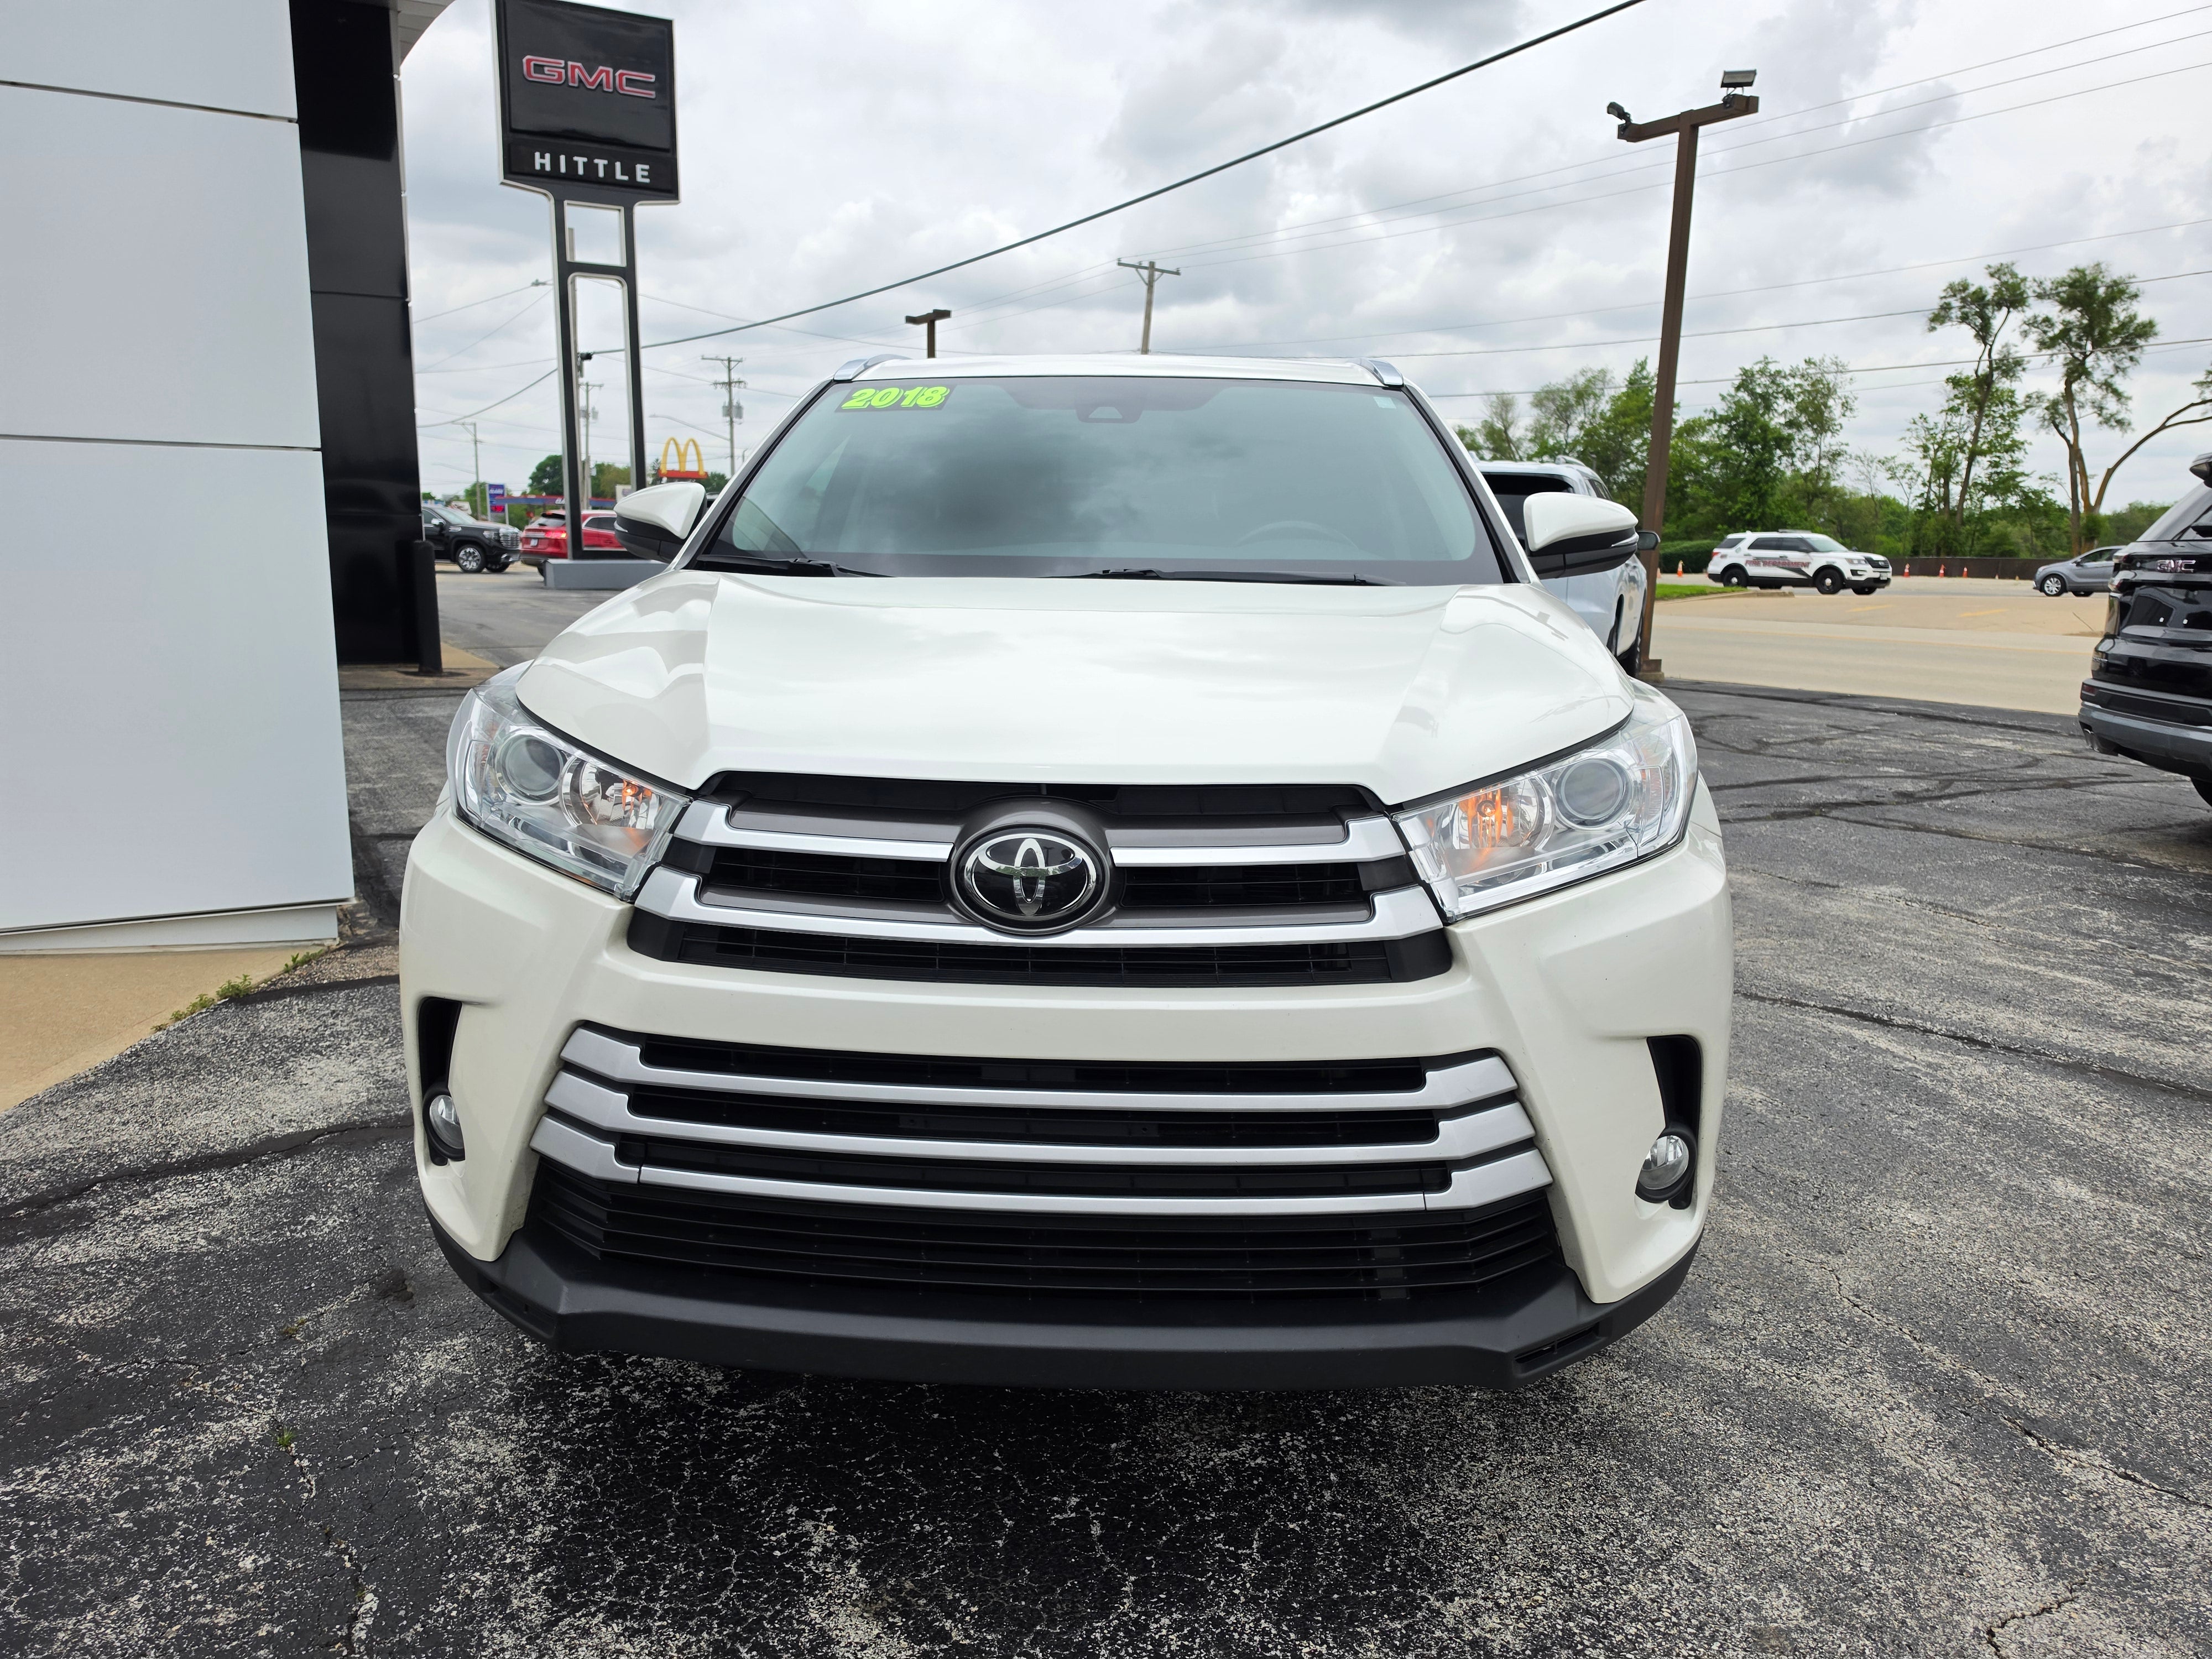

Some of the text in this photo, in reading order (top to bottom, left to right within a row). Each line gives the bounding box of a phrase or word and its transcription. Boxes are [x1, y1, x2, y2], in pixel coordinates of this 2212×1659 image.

[523, 55, 655, 98] GMC
[534, 152, 650, 183] HITTLE
[841, 386, 950, 409] 2018
[1762, 560, 1812, 568] DEPARTMENT
[2157, 559, 2197, 573] GMC
